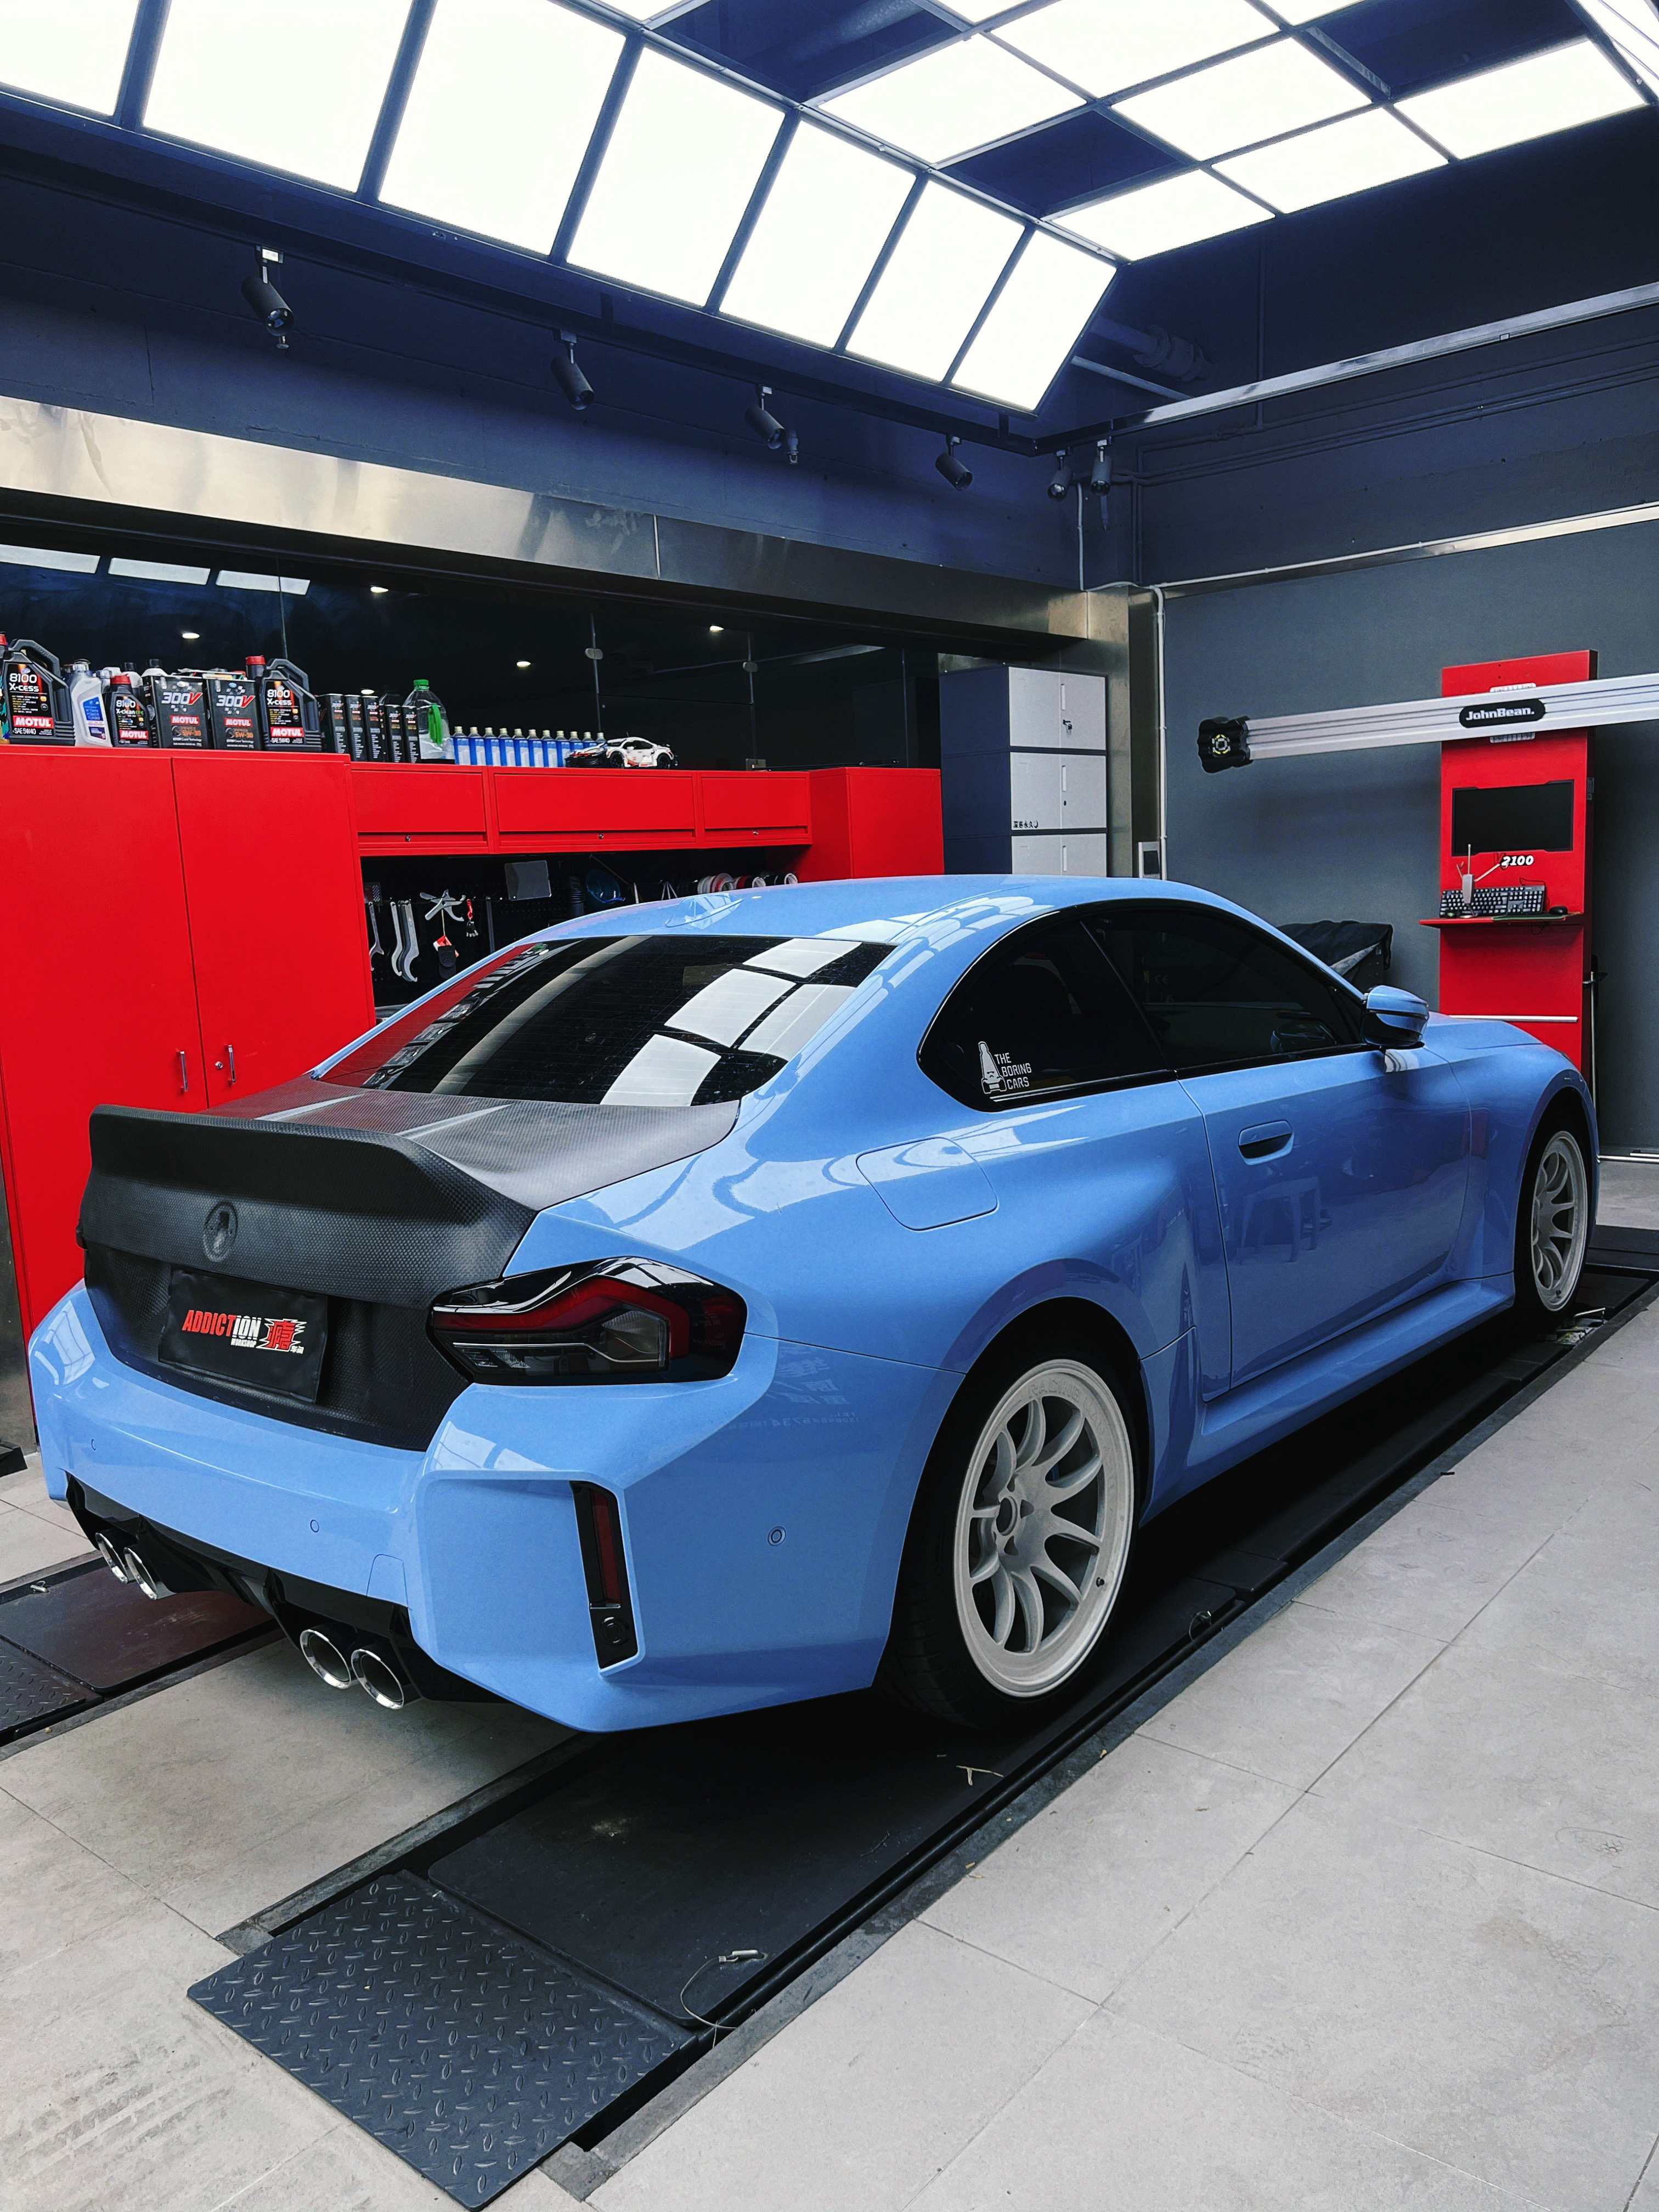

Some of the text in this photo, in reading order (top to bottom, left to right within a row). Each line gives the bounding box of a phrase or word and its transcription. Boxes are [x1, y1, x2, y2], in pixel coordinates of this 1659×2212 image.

[9, 673, 37, 684] 8100
[9, 682, 40, 692] X-cess
[267, 689, 290, 698] 8100
[116, 699, 136, 708] 8100
[161, 692, 203, 706] 300V
[216, 695, 256, 708] 300V
[15, 717, 52, 727] MOTUL
[172, 716, 199, 724] MOTUL
[120, 730, 147, 738] MOTUL
[272, 728, 302, 737] MOTUL
[994, 1053, 1012, 1064] THE
[1001, 1063, 1032, 1077] BORING
[1007, 1076, 1030, 1090] CARS
[182, 1310, 262, 1340] ADDICTION
